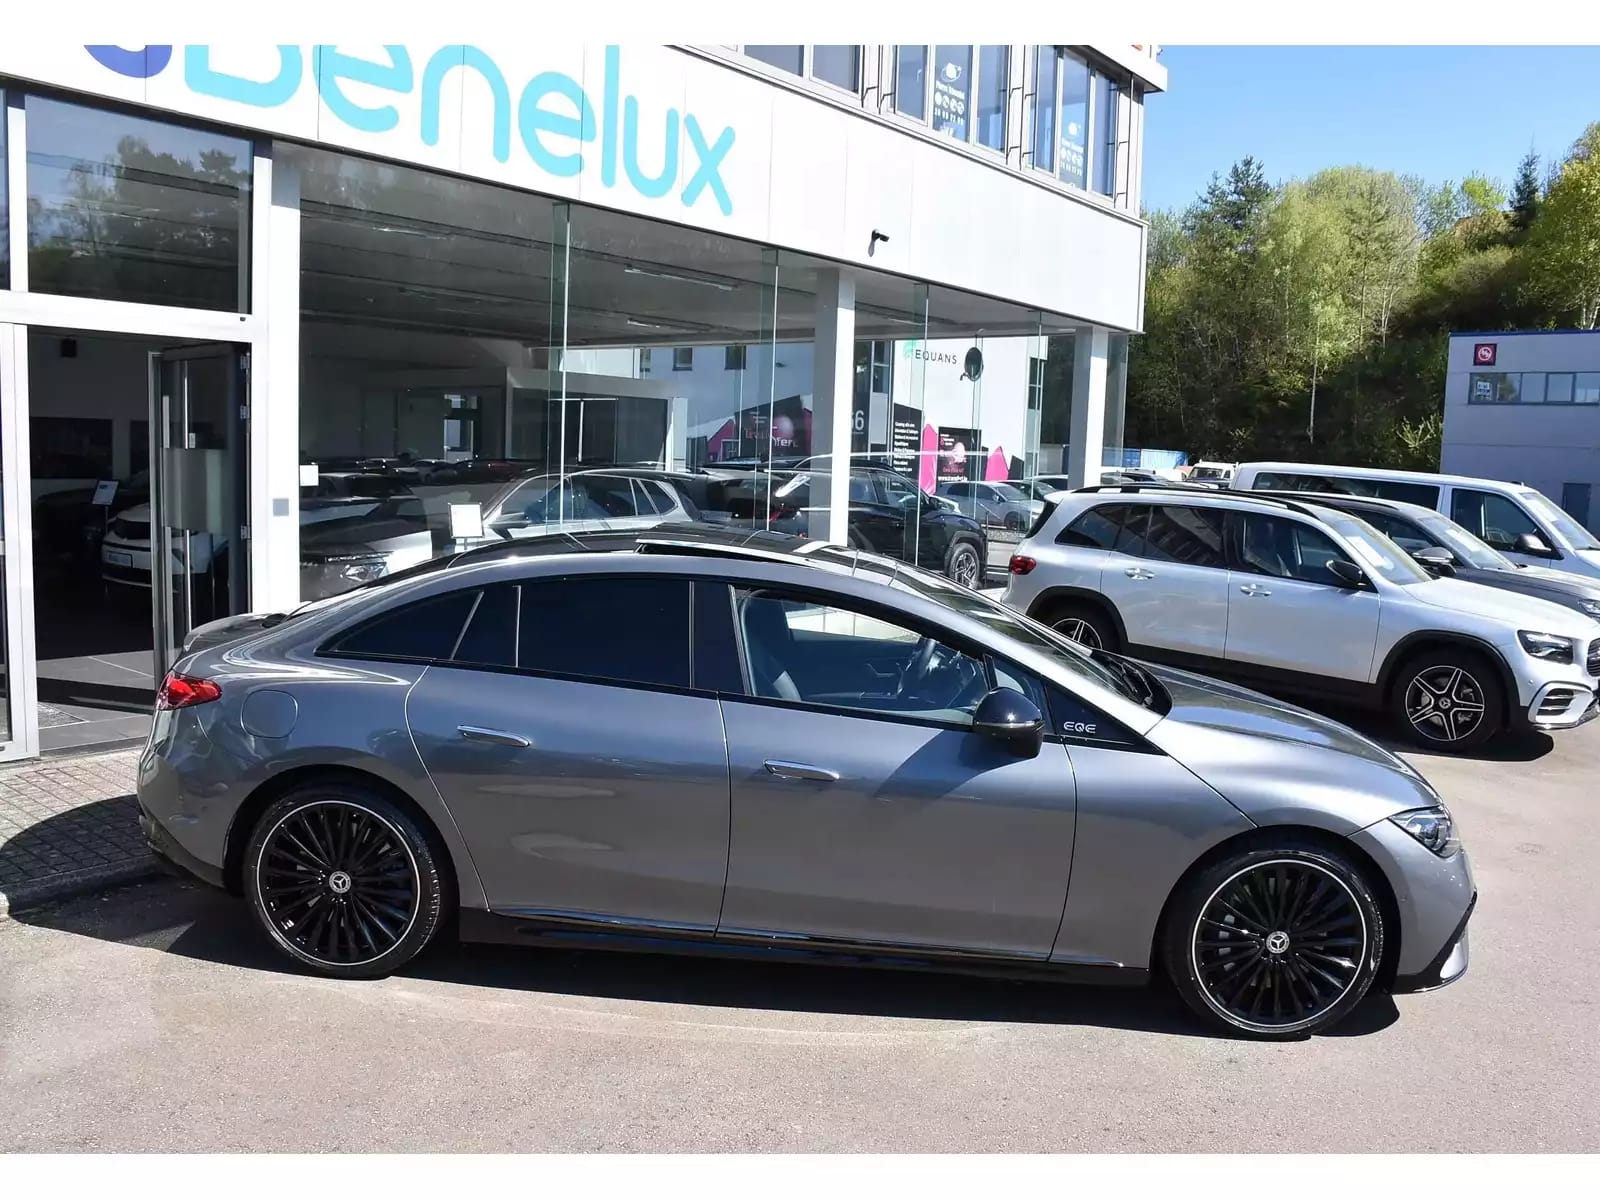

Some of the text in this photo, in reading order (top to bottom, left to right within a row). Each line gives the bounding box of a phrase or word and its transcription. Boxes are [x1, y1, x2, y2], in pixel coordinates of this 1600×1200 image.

[915, 349, 957, 364] EQUANS
[851, 410, 865, 431] 6
[1063, 721, 1097, 734] EQE
